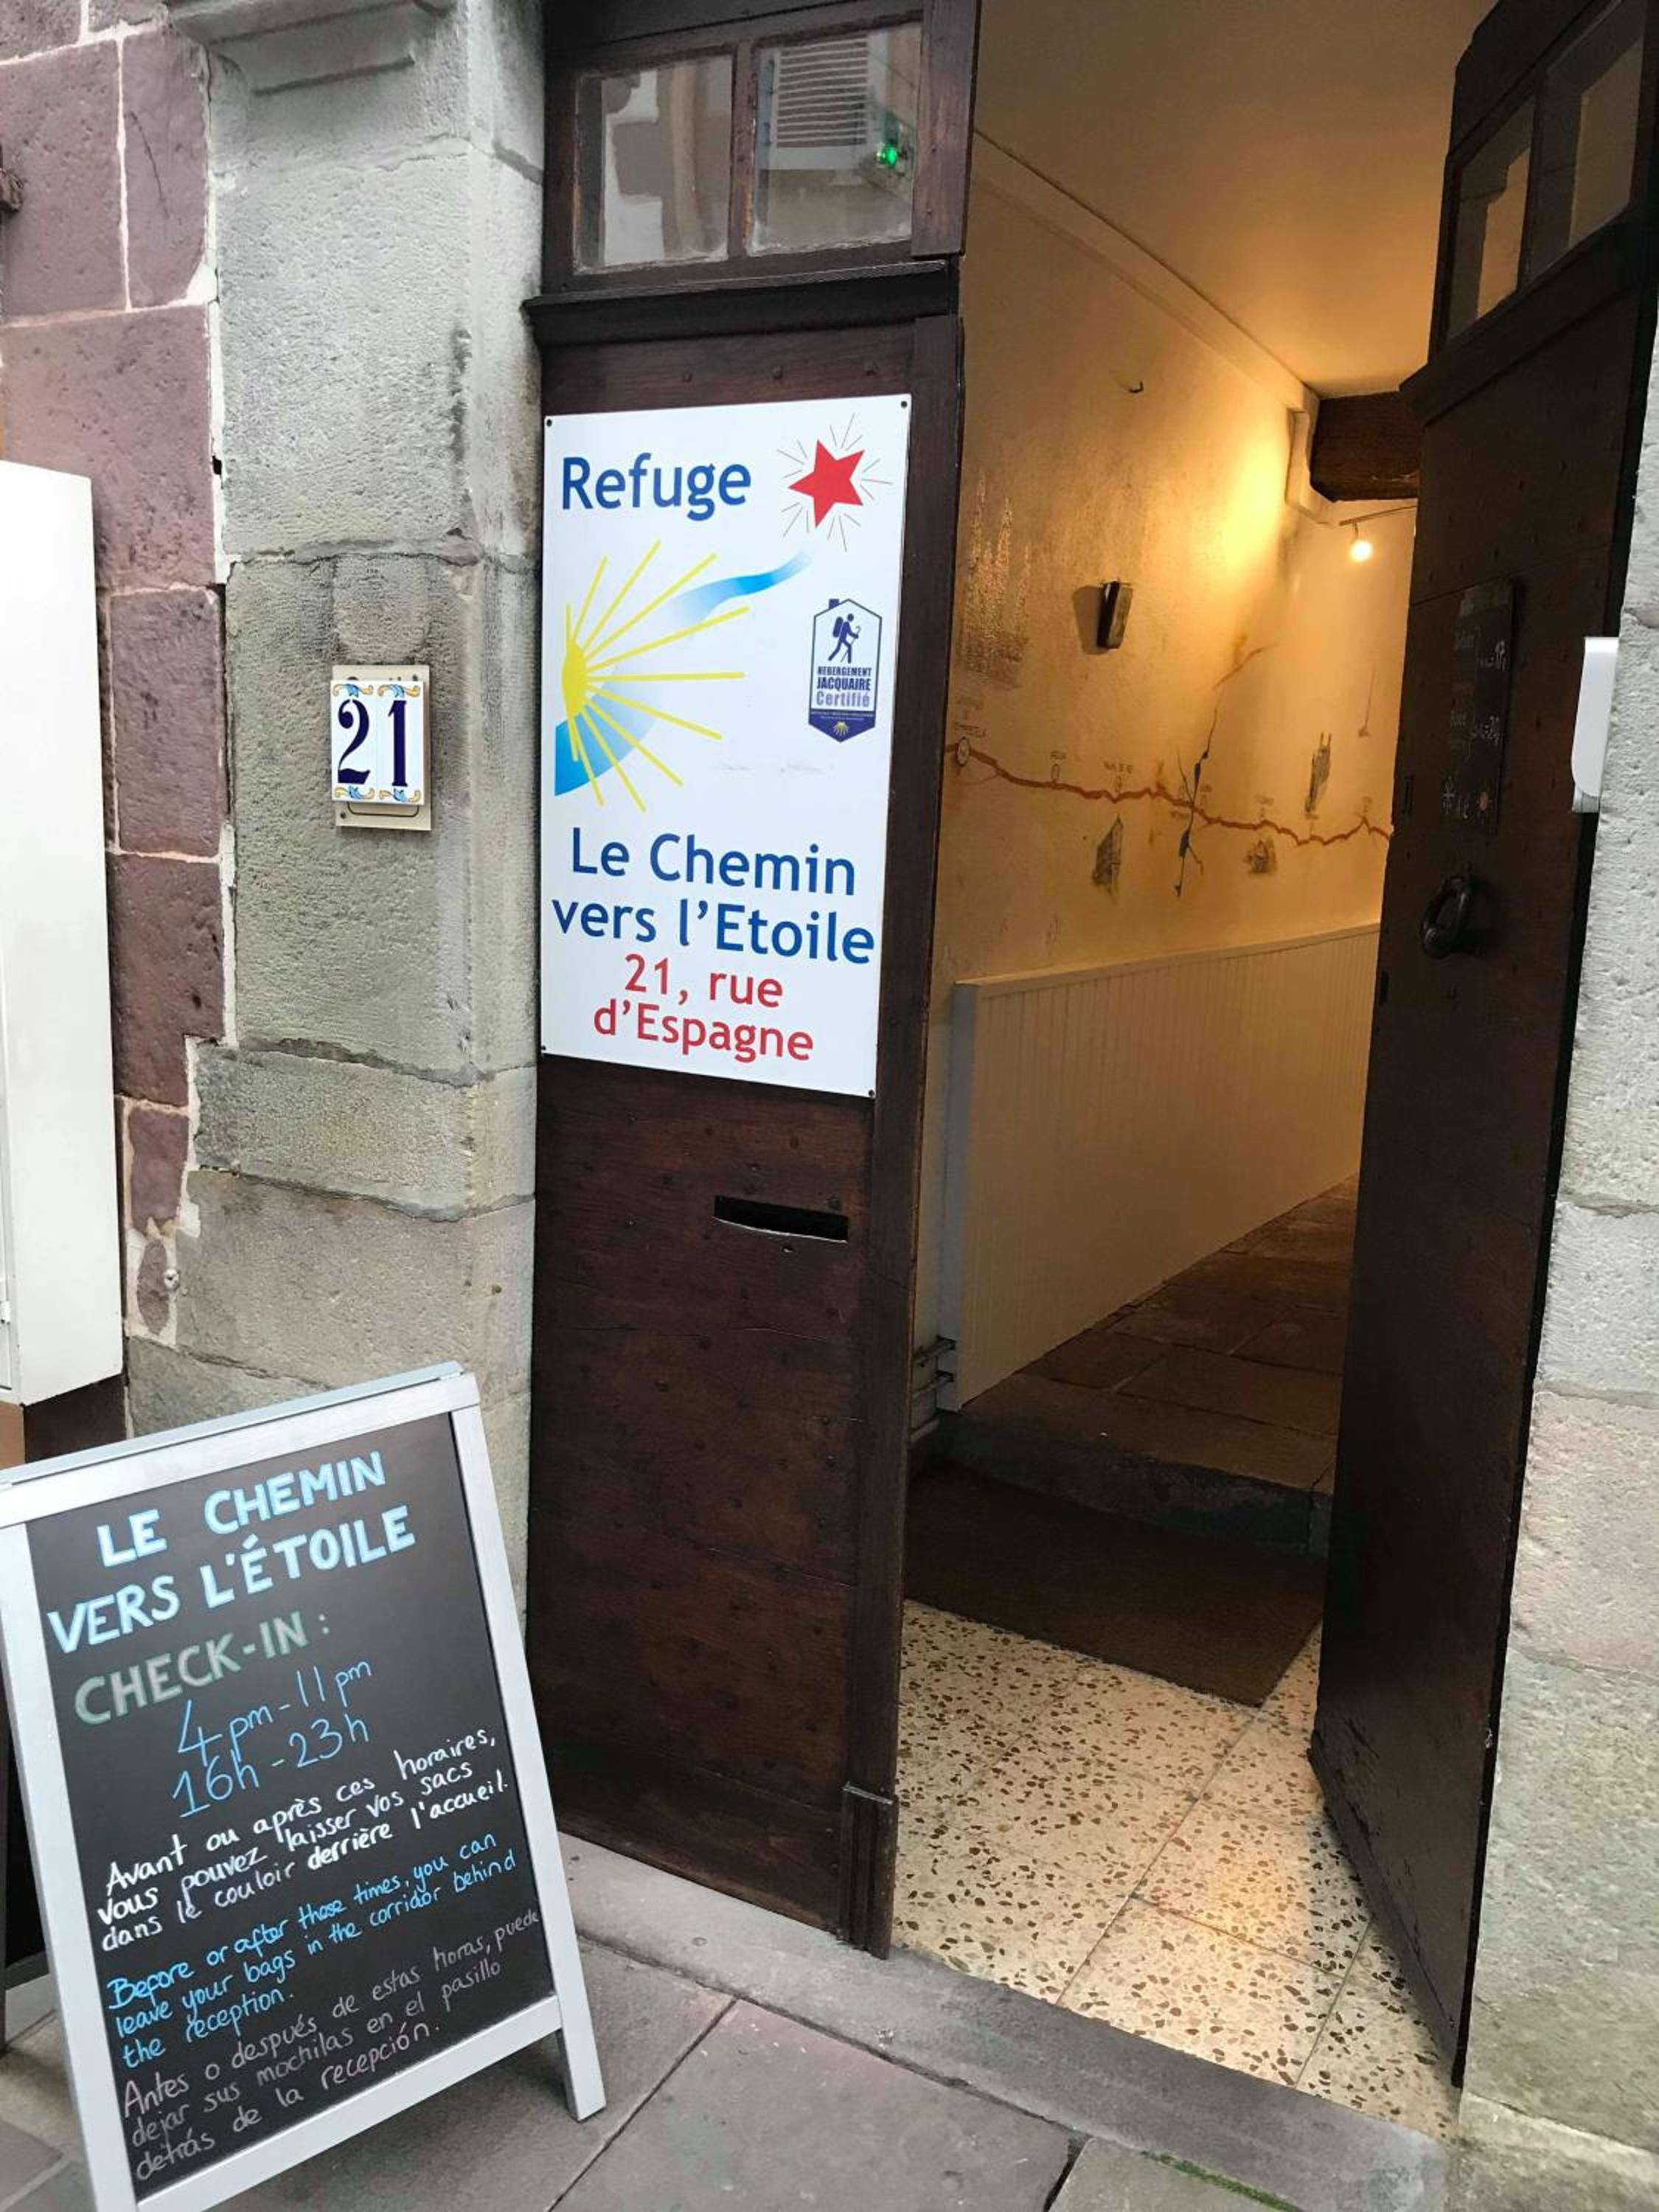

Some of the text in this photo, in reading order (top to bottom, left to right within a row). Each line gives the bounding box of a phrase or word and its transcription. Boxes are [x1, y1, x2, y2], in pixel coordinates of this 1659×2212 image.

[563, 452, 751, 521] Refuge
[337, 699, 408, 787] 21
[815, 691, 870, 708] Certifié
[816, 676, 871, 691] JACQUAIRE
[552, 899, 657, 942] vers
[572, 827, 855, 895] Le Chemin
[624, 953, 785, 1008] 21, rue
[96, 1450, 386, 1568] LE CHEMIN
[46, 1505, 416, 1653] VERS L'ÉTOILE
[97, 1762, 473, 1925] vous pouvez laisser vos sacs
[102, 1769, 509, 1952] dans le couloir derrière l'accueil.
[106, 1729, 495, 1896] Avant ou après ces horaires,
[106, 1961, 195, 2009] Before
[206, 1945, 229, 1966] or
[234, 1919, 288, 1958] after
[352, 1875, 410, 1905] times,
[413, 1856, 449, 1893] you
[459, 1834, 497, 1860] can
[116, 1848, 516, 2038] leave your bags in the corridor behind
[122, 1989, 294, 2069] the reception.
[124, 2071, 190, 2118] Antes
[205, 2062, 220, 2081] o
[231, 2014, 318, 2069] después
[332, 1994, 360, 2019] de
[372, 1966, 420, 2001] estas
[433, 1935, 491, 1972] horas,
[132, 1958, 502, 2147] dejar sus mochilas en el pasillo
[136, 2022, 440, 2182] detrás de la recepción.
